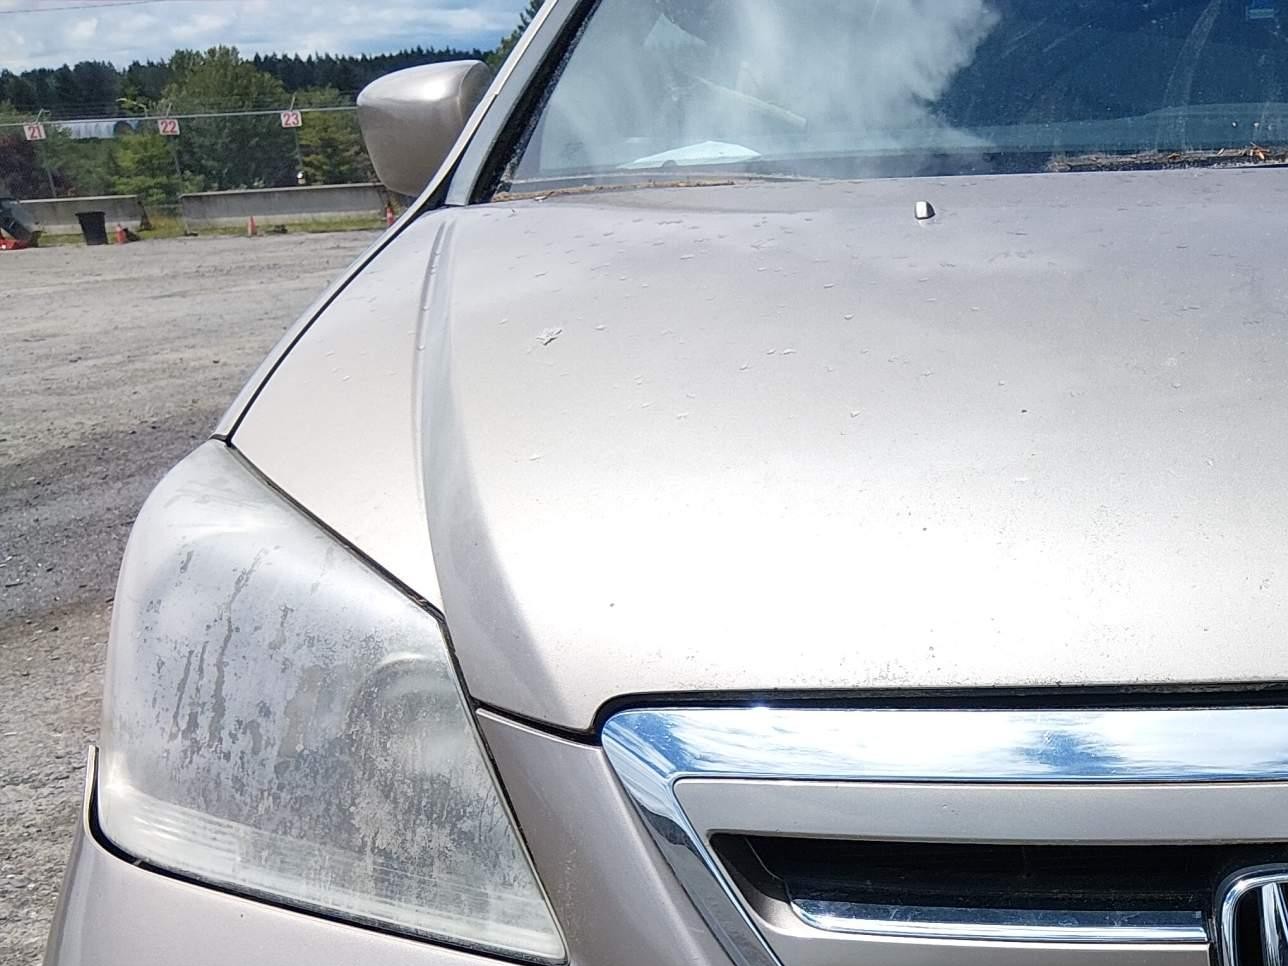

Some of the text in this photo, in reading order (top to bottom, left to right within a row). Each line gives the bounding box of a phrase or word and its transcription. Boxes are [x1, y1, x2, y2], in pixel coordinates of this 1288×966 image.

[283, 112, 299, 125] 23
[28, 126, 42, 138] 21
[160, 120, 177, 133] 22
